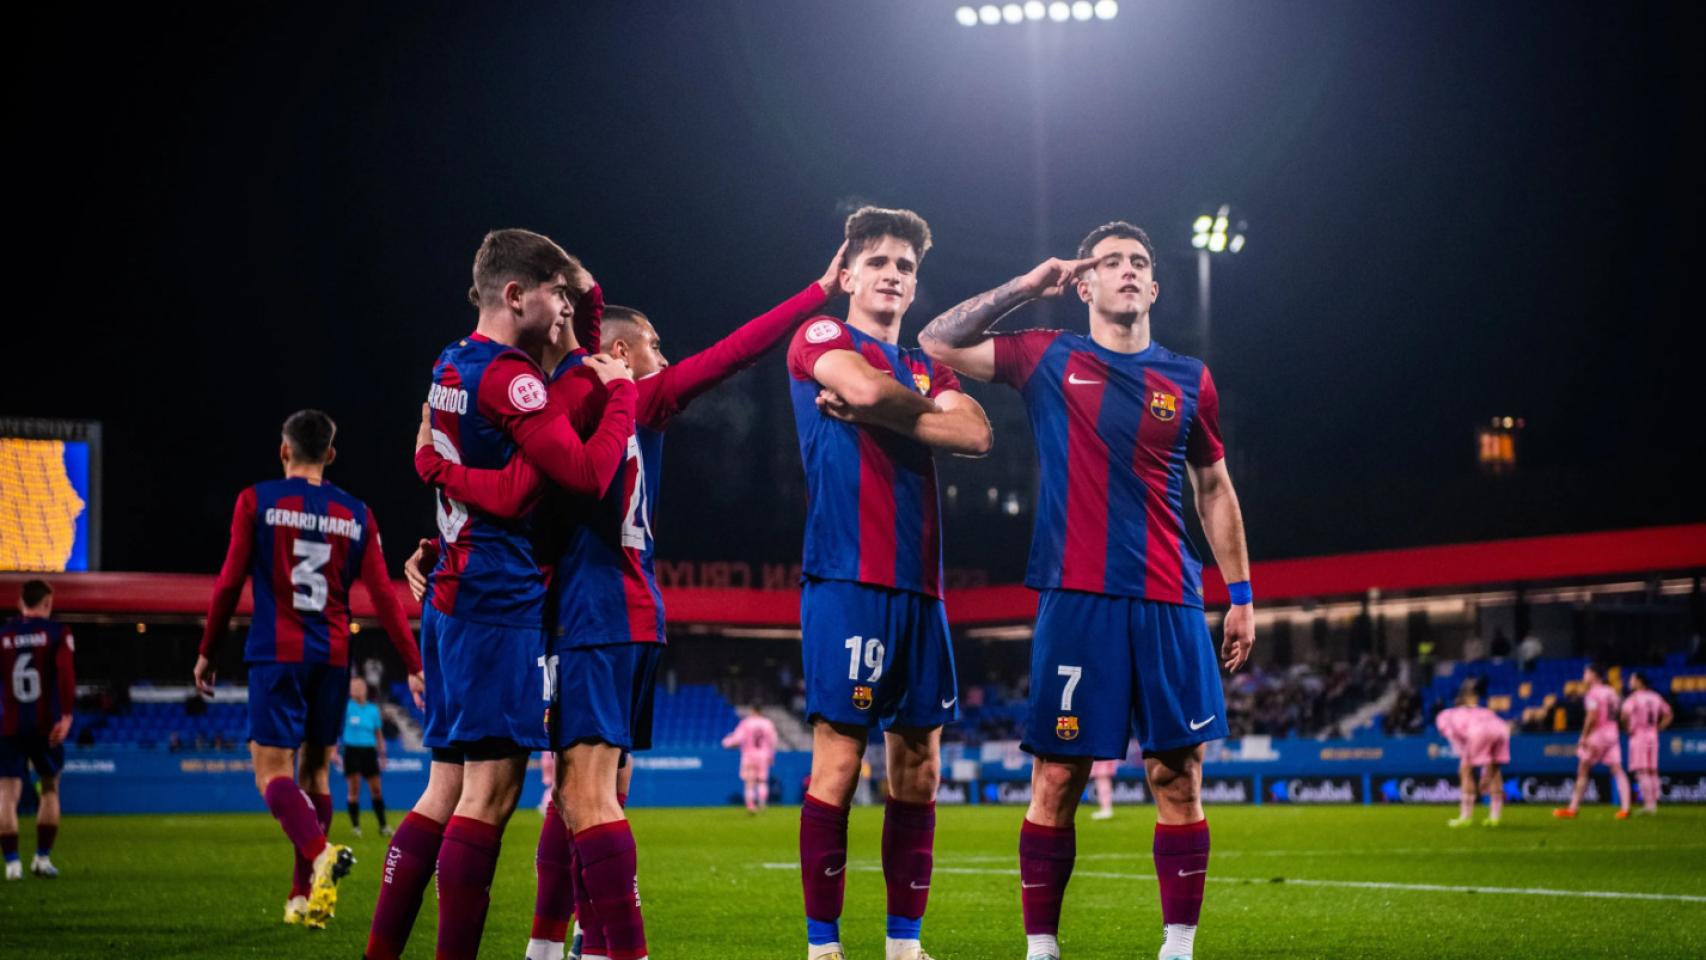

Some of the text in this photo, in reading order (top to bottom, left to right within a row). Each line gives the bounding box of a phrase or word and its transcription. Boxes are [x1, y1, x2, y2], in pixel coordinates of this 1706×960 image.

[428, 382, 468, 415] ARRIDO
[621, 434, 654, 550] 2
[265, 508, 316, 530] GERARD
[291, 538, 332, 612] 3
[12, 653, 41, 702] 6
[844, 635, 885, 683] 19
[1057, 665, 1082, 711] 7
